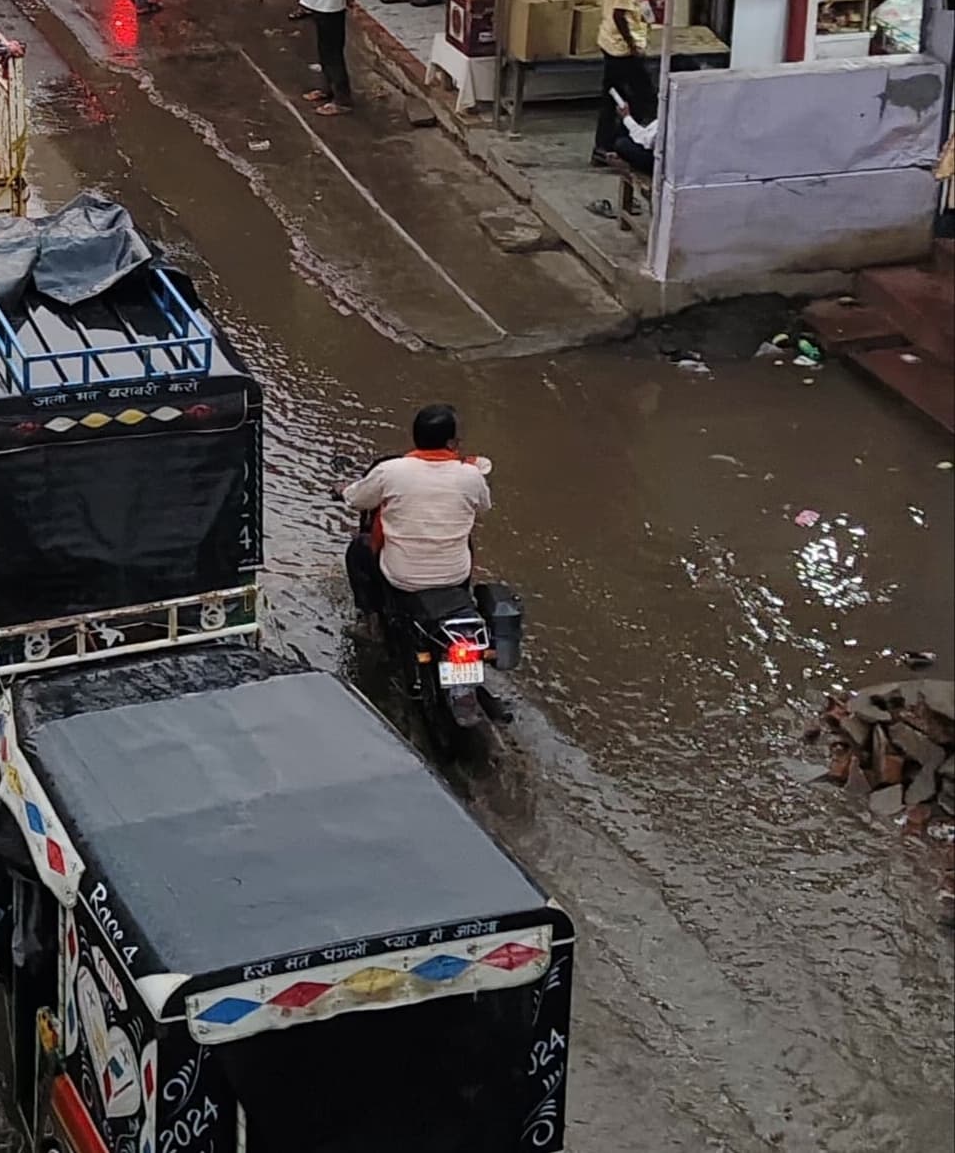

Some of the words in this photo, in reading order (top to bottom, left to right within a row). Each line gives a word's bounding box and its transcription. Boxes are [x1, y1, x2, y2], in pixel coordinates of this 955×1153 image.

[89, 881, 124, 944] Race
[122, 946, 139, 966] 4
[158, 1095, 220, 1153] 2024
